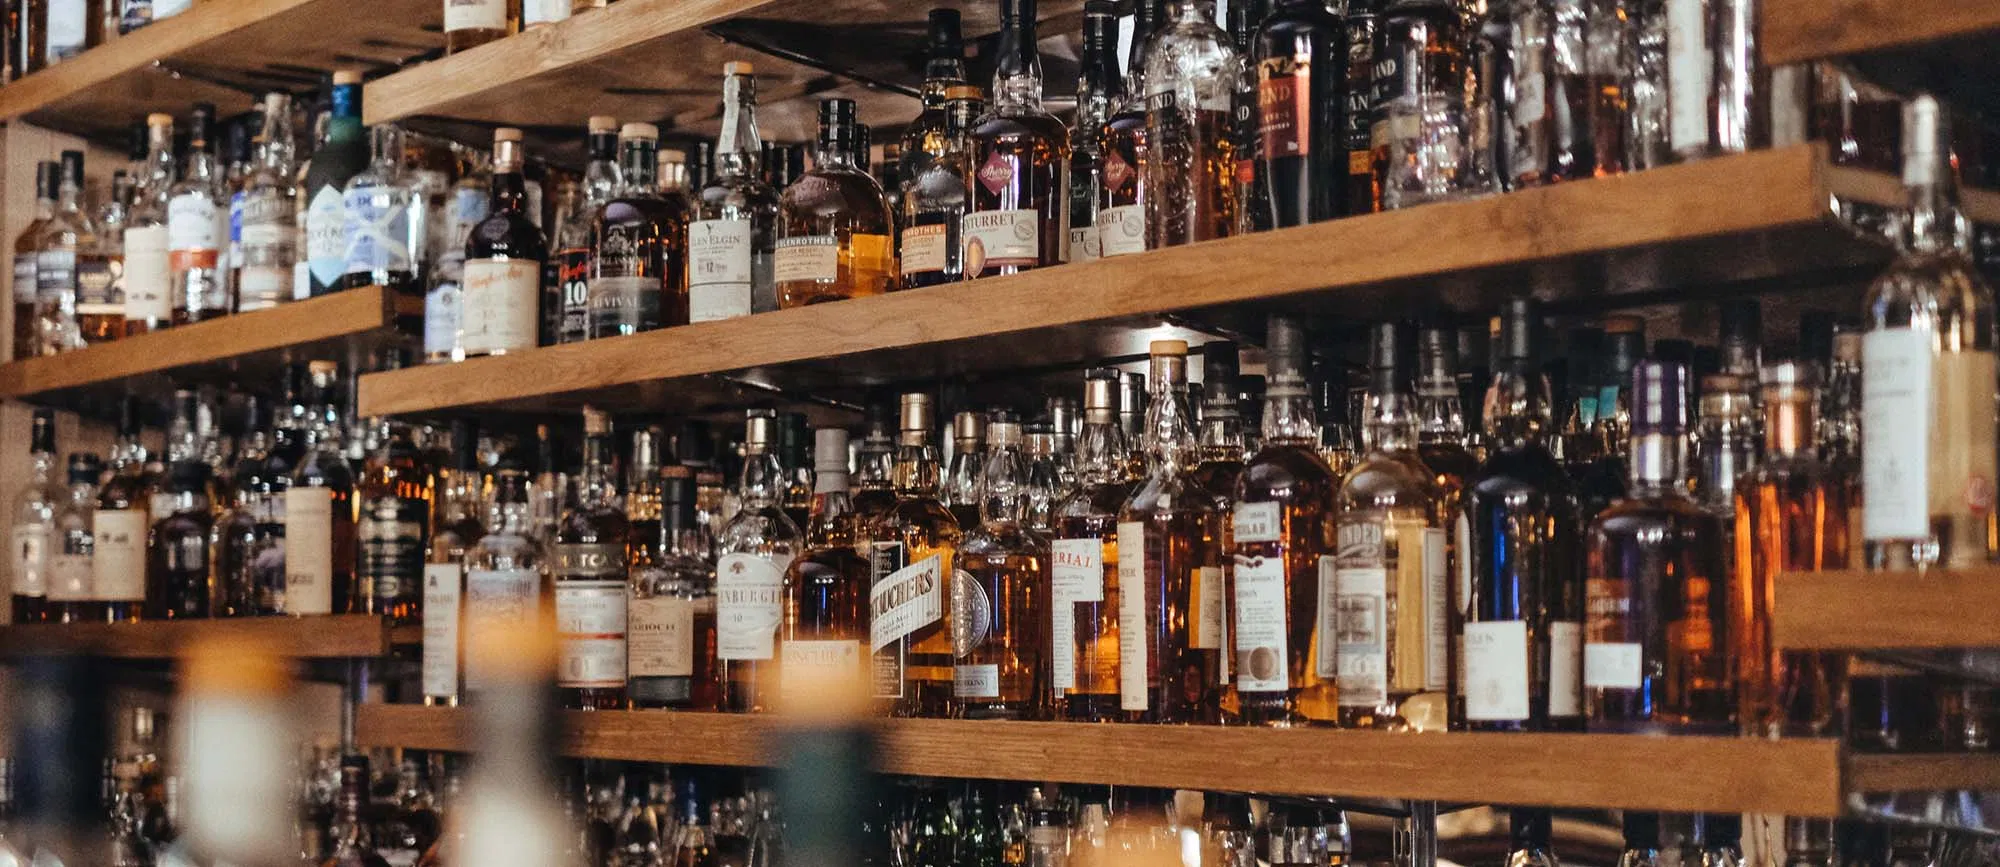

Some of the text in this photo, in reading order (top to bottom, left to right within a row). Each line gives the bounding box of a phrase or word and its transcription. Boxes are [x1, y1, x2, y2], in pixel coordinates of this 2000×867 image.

[981, 165, 1013, 179] Sherry
[709, 234, 741, 246] ELGIN
[564, 281, 588, 306] 10
